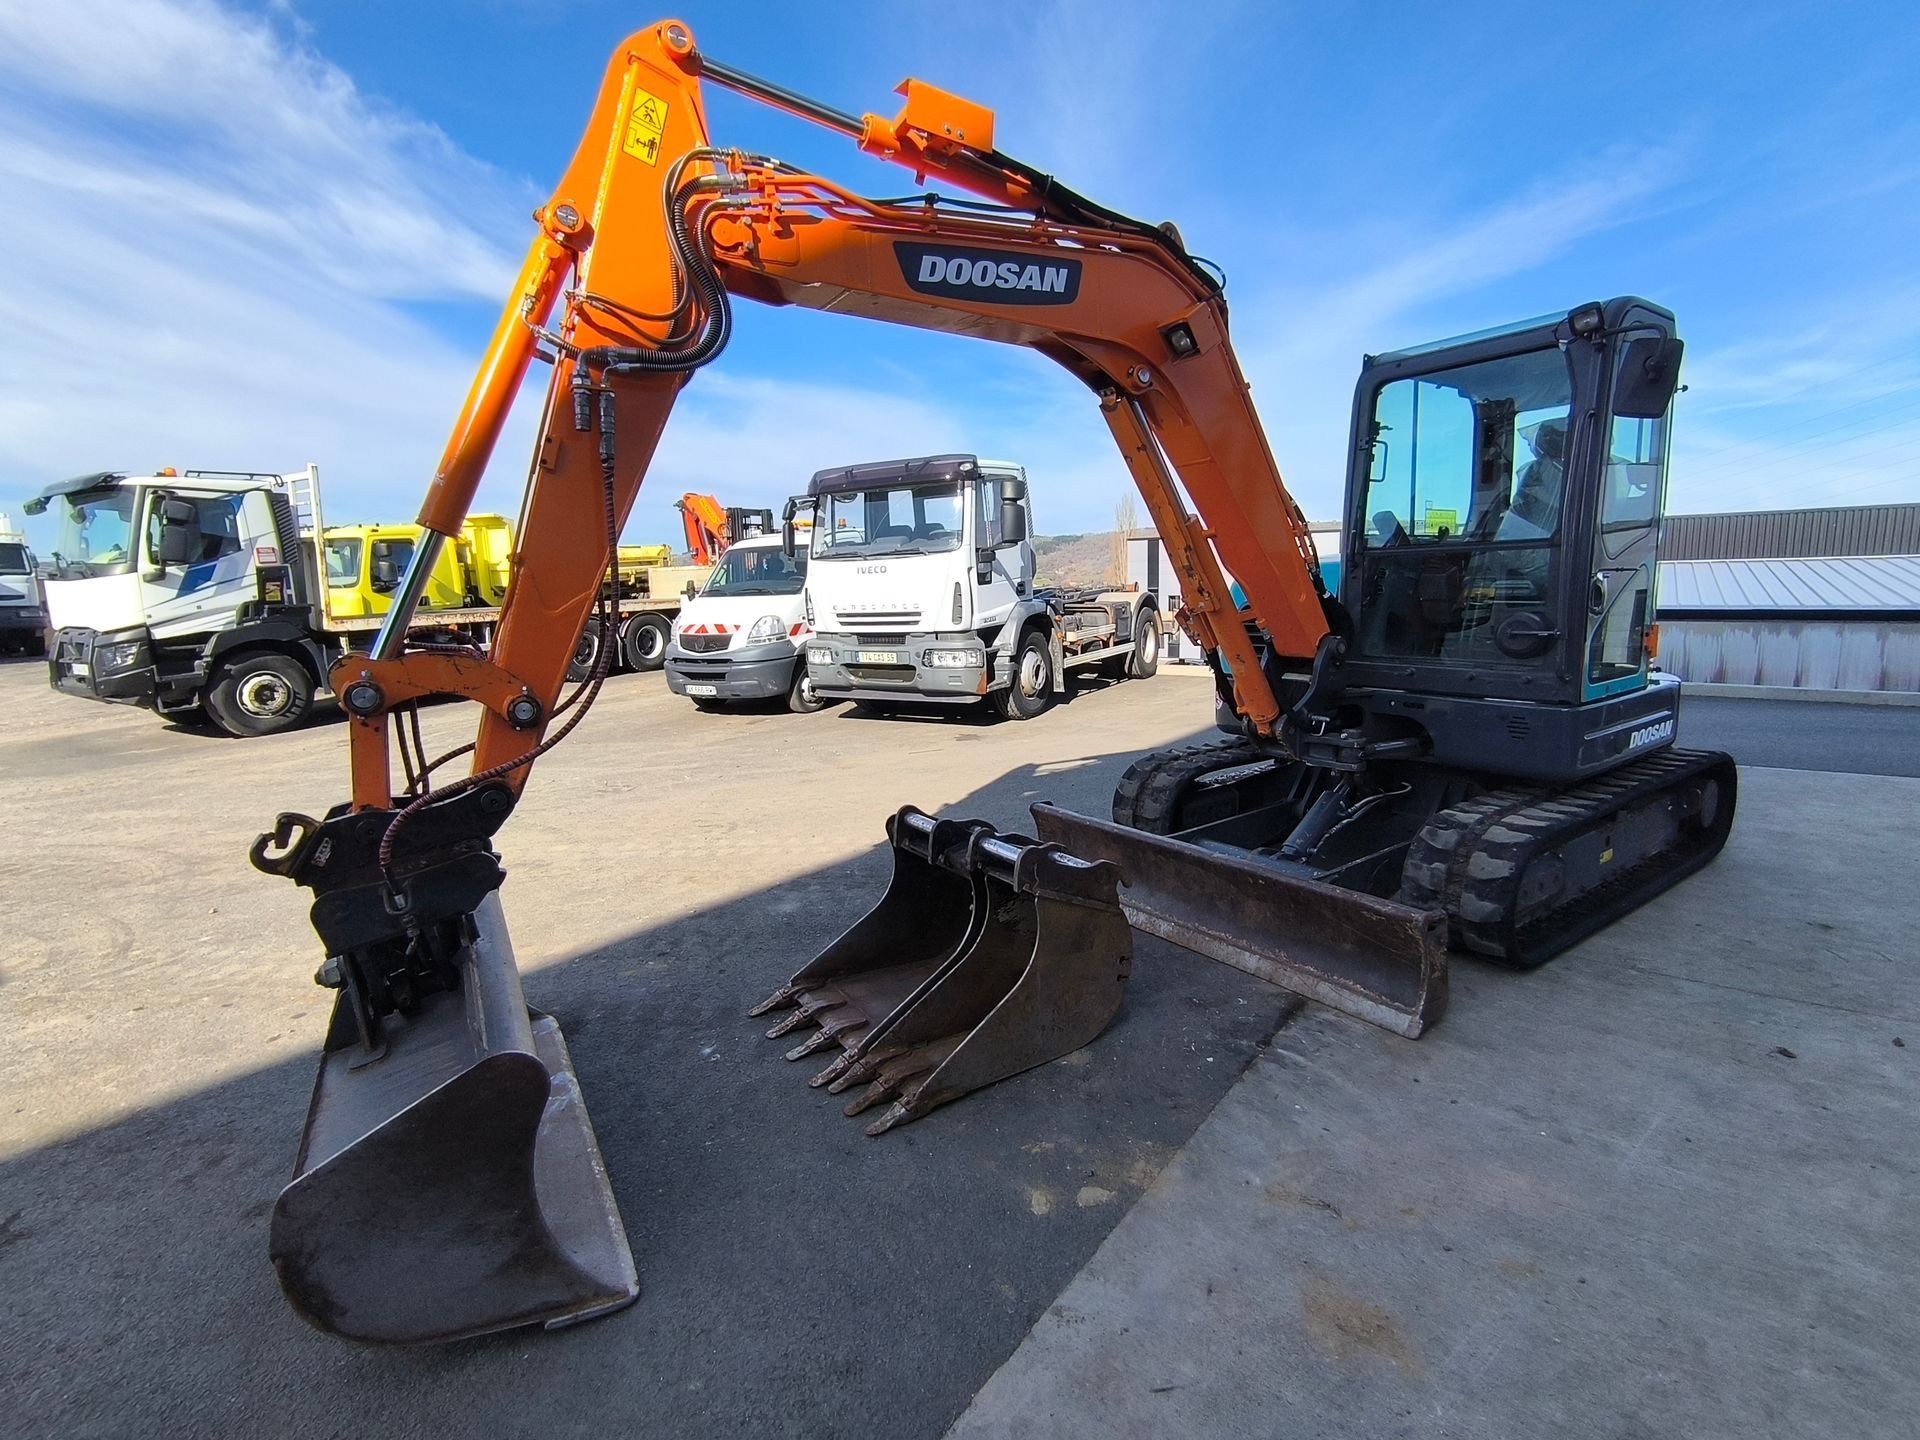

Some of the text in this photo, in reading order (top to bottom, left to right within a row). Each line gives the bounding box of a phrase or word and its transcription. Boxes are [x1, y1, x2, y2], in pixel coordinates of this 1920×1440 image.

[918, 255, 1068, 293] DOOSAN
[856, 565, 887, 575] IVECO
[1629, 719, 1673, 749] DOOSAN
